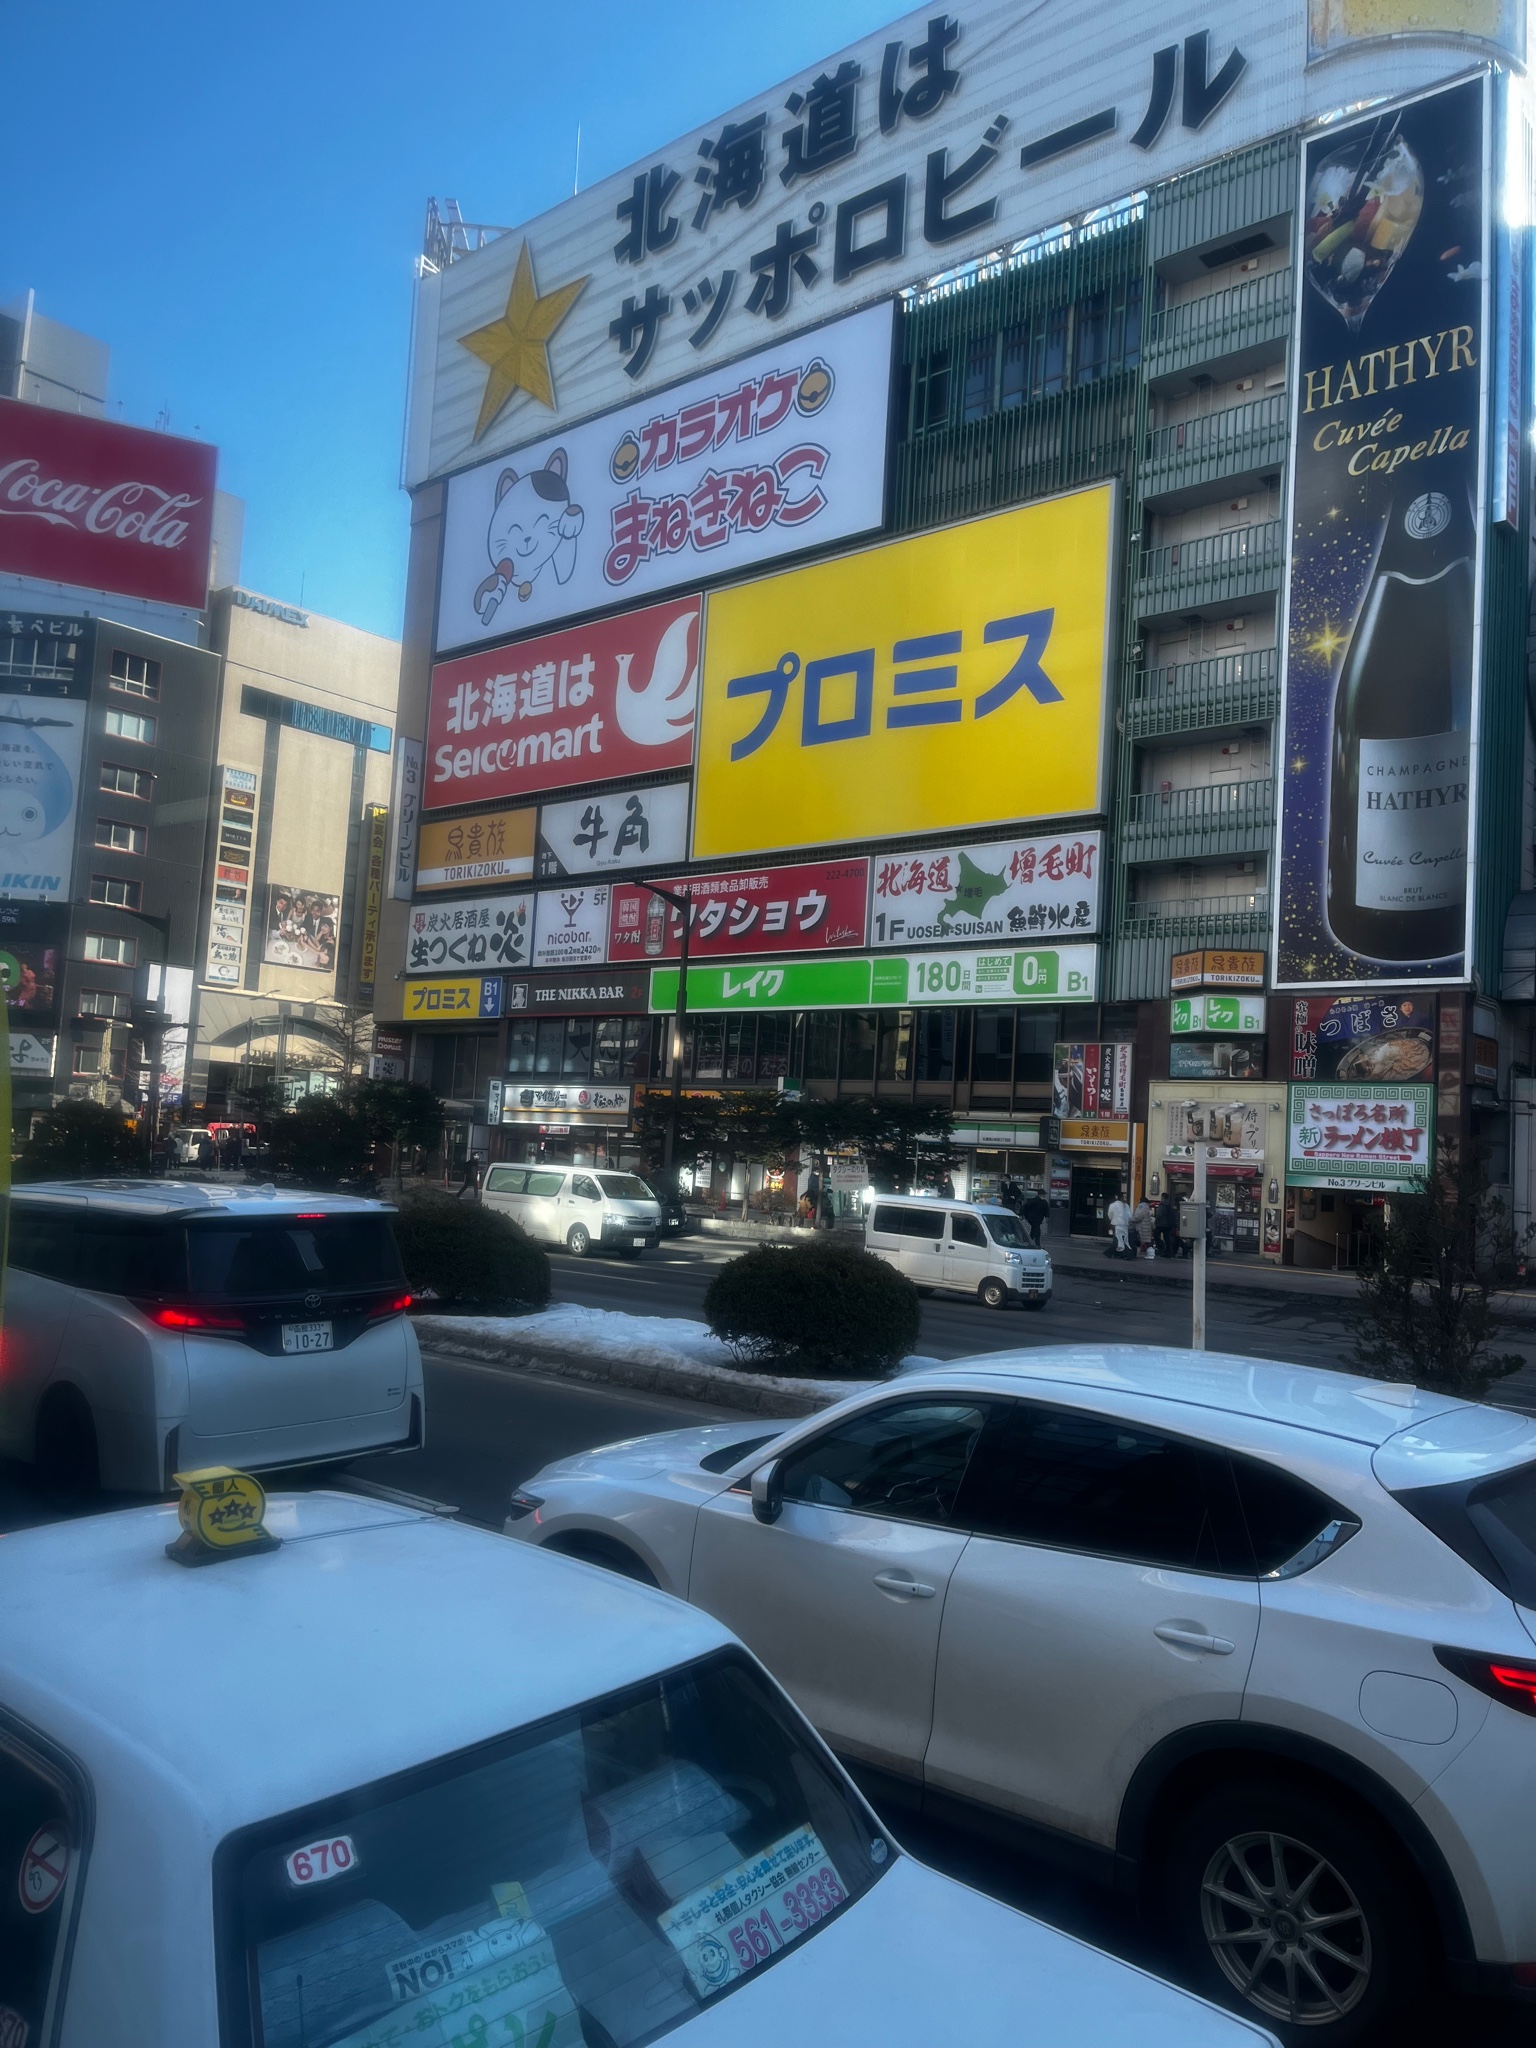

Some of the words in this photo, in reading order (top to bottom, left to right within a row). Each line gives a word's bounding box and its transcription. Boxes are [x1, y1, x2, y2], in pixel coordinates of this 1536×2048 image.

[613, 15, 961, 265] 北海道は
[609, 29, 1248, 378] サッポロビール
[1303, 325, 1477, 414] HATHYR
[639, 369, 802, 477] カラオケ
[1313, 407, 1403, 452] Cuvée
[1347, 425, 1471, 476] Capella
[0, 458, 204, 549] Coca-Cola
[605, 444, 830, 585] まねきねこ
[446, 653, 595, 734] 北海道は
[727, 607, 1064, 762] プロミス
[433, 713, 603, 782] Seicomart
[1367, 755, 1468, 776] CHAMPAGNE
[1366, 782, 1467, 811] HATHYR
[573, 794, 650, 858] 牛角
[444, 860, 505, 881] TORIKIZOKU
[825, 867, 865, 880] 222-4700
[1009, 841, 1097, 885] 増毛町
[876, 856, 954, 898] 北海道
[593, 892, 607, 906] 5F
[963, 886, 983, 898] 増毛
[1403, 886, 1423, 894] BRUT
[2, 916, 17, 924] 59%
[426, 907, 490, 933] 炭火居酒屋
[875, 912, 905, 941] 1F
[1007, 901, 1091, 932] 魚鮮水産
[547, 931, 590, 945] nicobar
[614, 931, 641, 944] ワタ酎
[410, 933, 487, 968] 生つくね
[978, 957, 1010, 967] はじめて
[917, 960, 961, 993] 180
[1022, 955, 1038, 986] 0
[1038, 974, 1047, 984] 円
[1067, 971, 1088, 992] B1
[1211, 974, 1256, 983] TORIKIZOKU
[484, 981, 497, 996] B1
[535, 988, 556, 1002] THE
[557, 987, 597, 1001] NIKKA
[599, 986, 624, 999] BAR
[722, 969, 784, 998] レイク
[413, 986, 471, 1011] プロミス
[1174, 1003, 1188, 1025] レイク
[1192, 1015, 1202, 1028] B1
[1208, 999, 1234, 1023] レイク
[1244, 1015, 1260, 1029] B1
[377, 1042, 402, 1051] Donut
[378, 1036, 403, 1046] mister
[167, 1094, 179, 1103] 5F
[1308, 1103, 1408, 1124] さっぽろ名所
[1299, 1127, 1319, 1145] 新
[1323, 1126, 1424, 1152] ラーメン横丁
[833, 1165, 866, 1174] タクシーのりば
[1327, 1178, 1346, 1187] No.3
[1347, 1179, 1386, 1189] グリーンビル
[258, 1306, 365, 1320] VELLFIRE
[309, 1323, 321, 1332] 333
[295, 1332, 330, 1349] 10-27
[292, 1839, 351, 1881] 670
[727, 1866, 846, 1970] 561-3333
[395, 1954, 455, 2000] NO!
